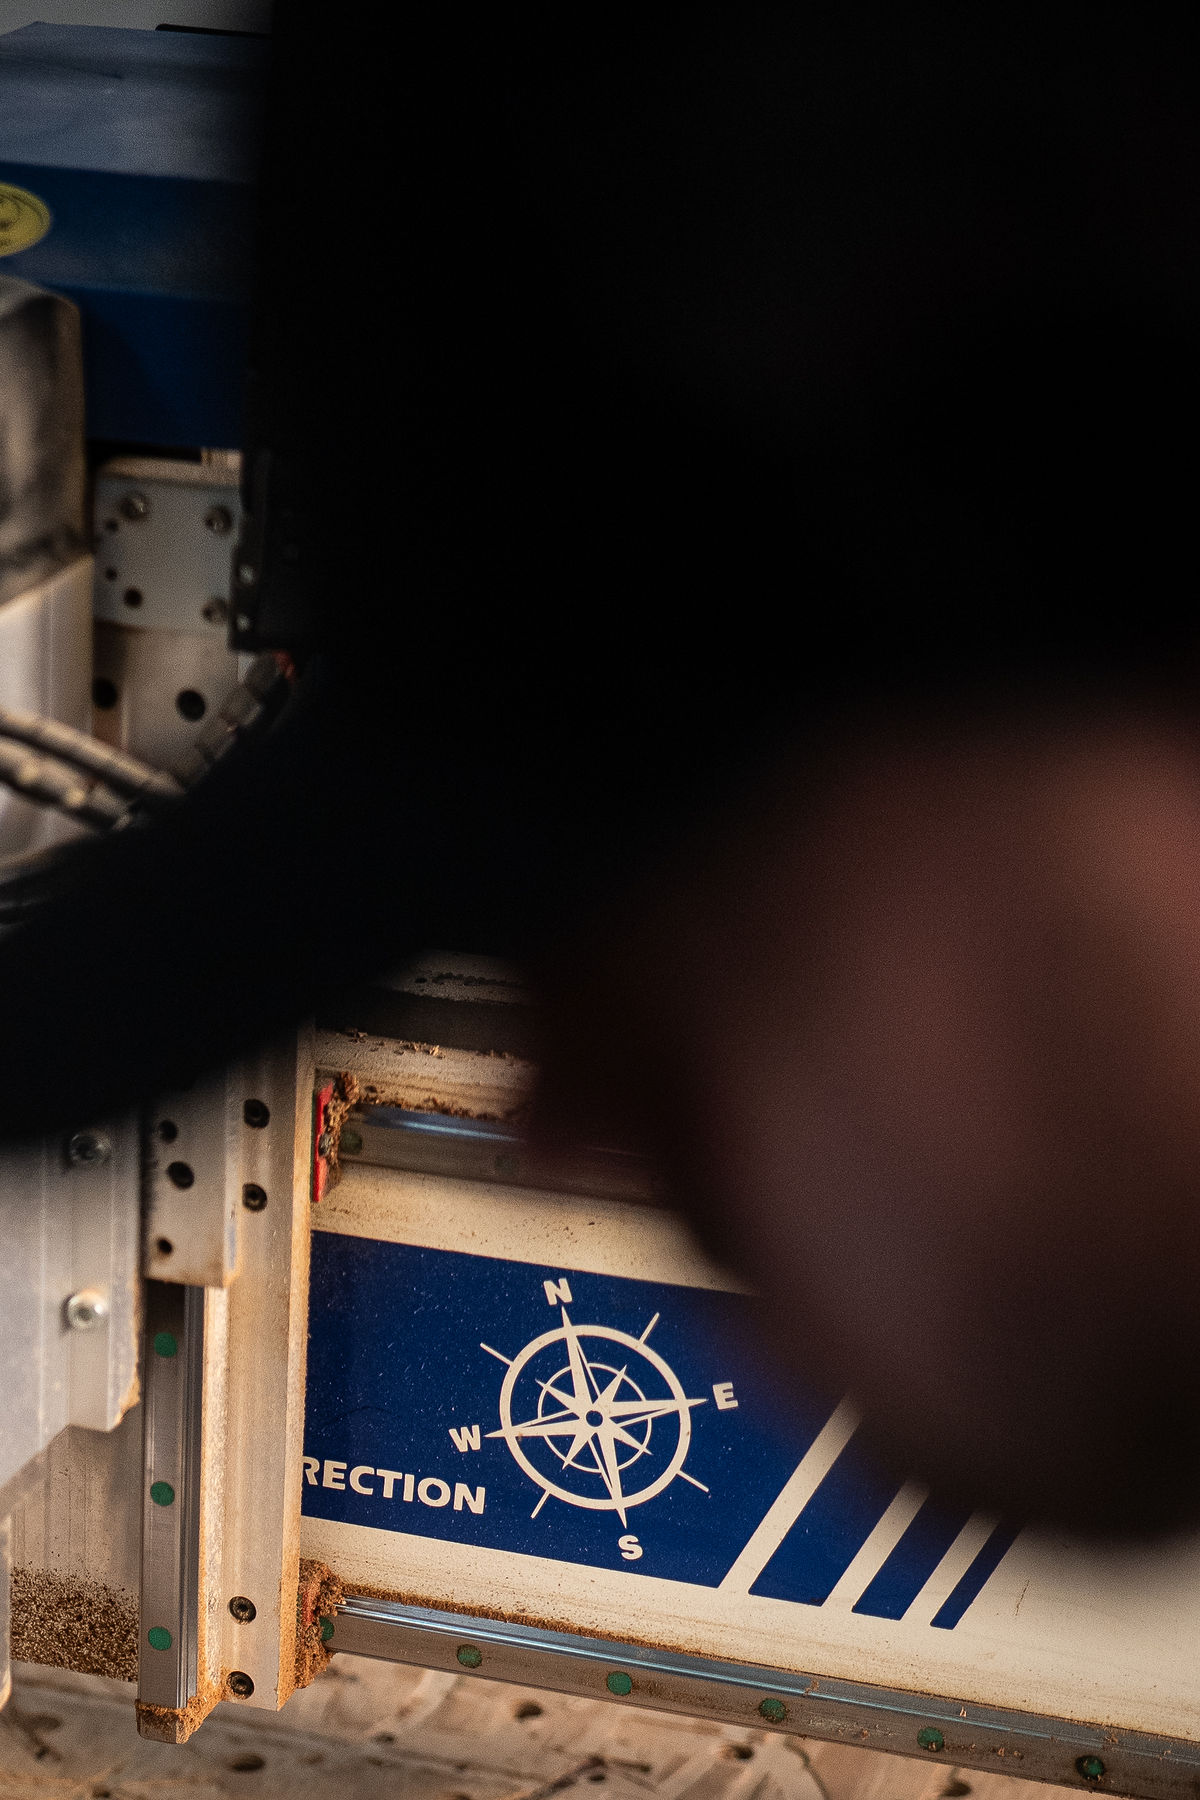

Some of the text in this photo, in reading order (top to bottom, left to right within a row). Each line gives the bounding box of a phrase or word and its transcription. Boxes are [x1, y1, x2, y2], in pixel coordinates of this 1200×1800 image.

[543, 1277, 573, 1306] N
[712, 1382, 739, 1410] E
[448, 1424, 481, 1453] W
[617, 1534, 643, 1560] S
